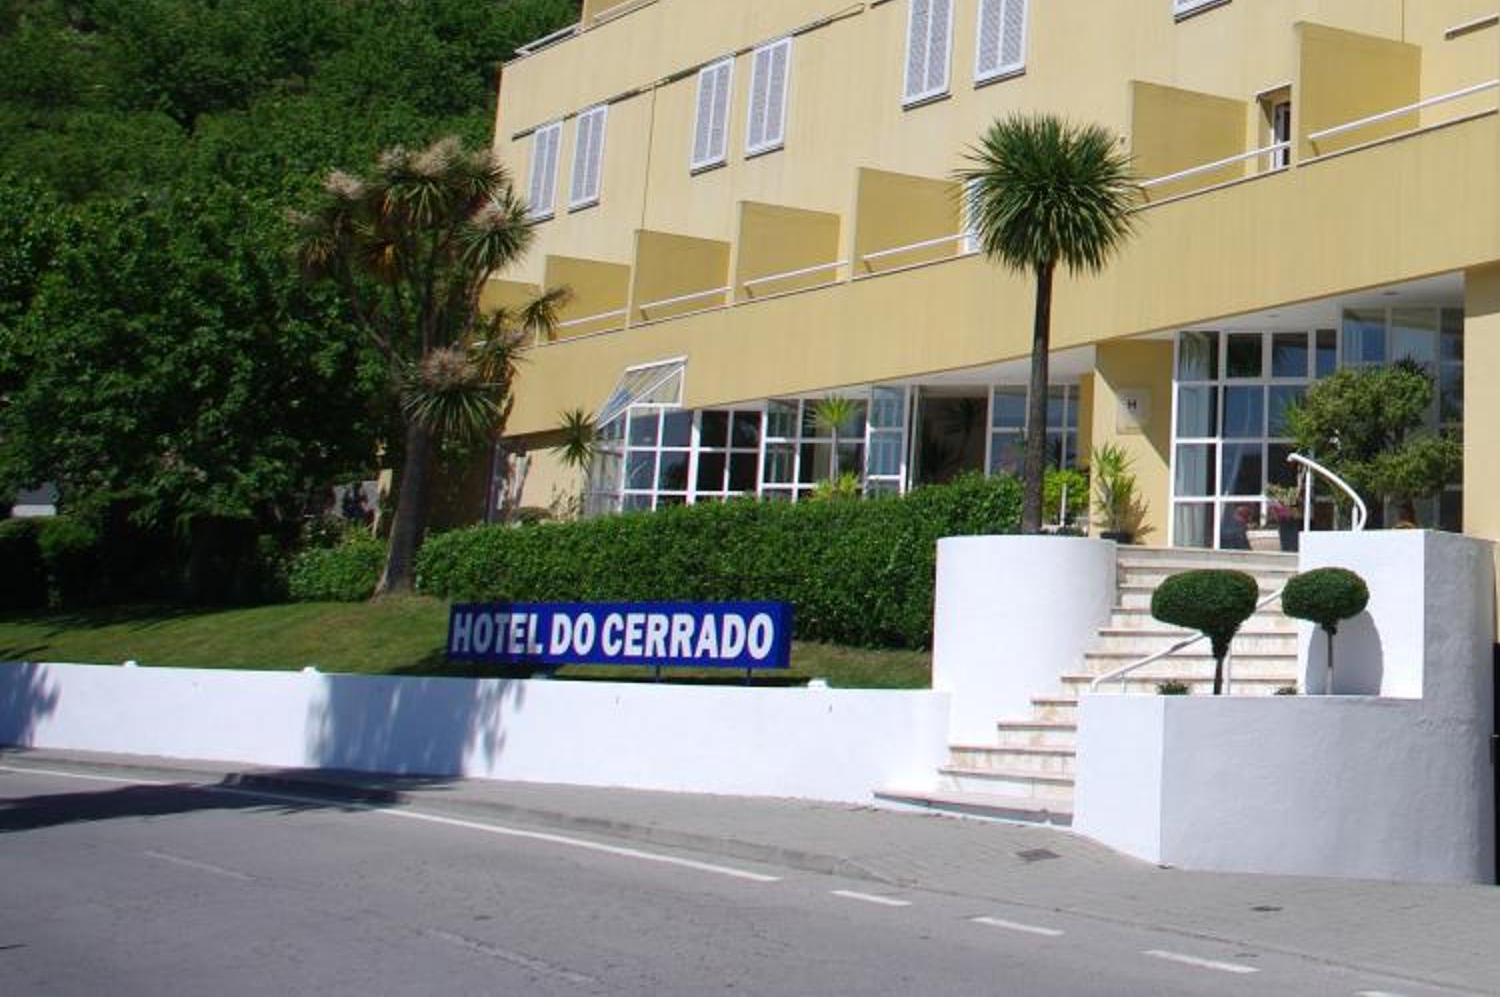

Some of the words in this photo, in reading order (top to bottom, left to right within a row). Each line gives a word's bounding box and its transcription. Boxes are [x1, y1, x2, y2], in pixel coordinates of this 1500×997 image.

[451, 612, 544, 654] HOTEL
[549, 612, 596, 656] DO
[601, 612, 775, 660] CERRADO
